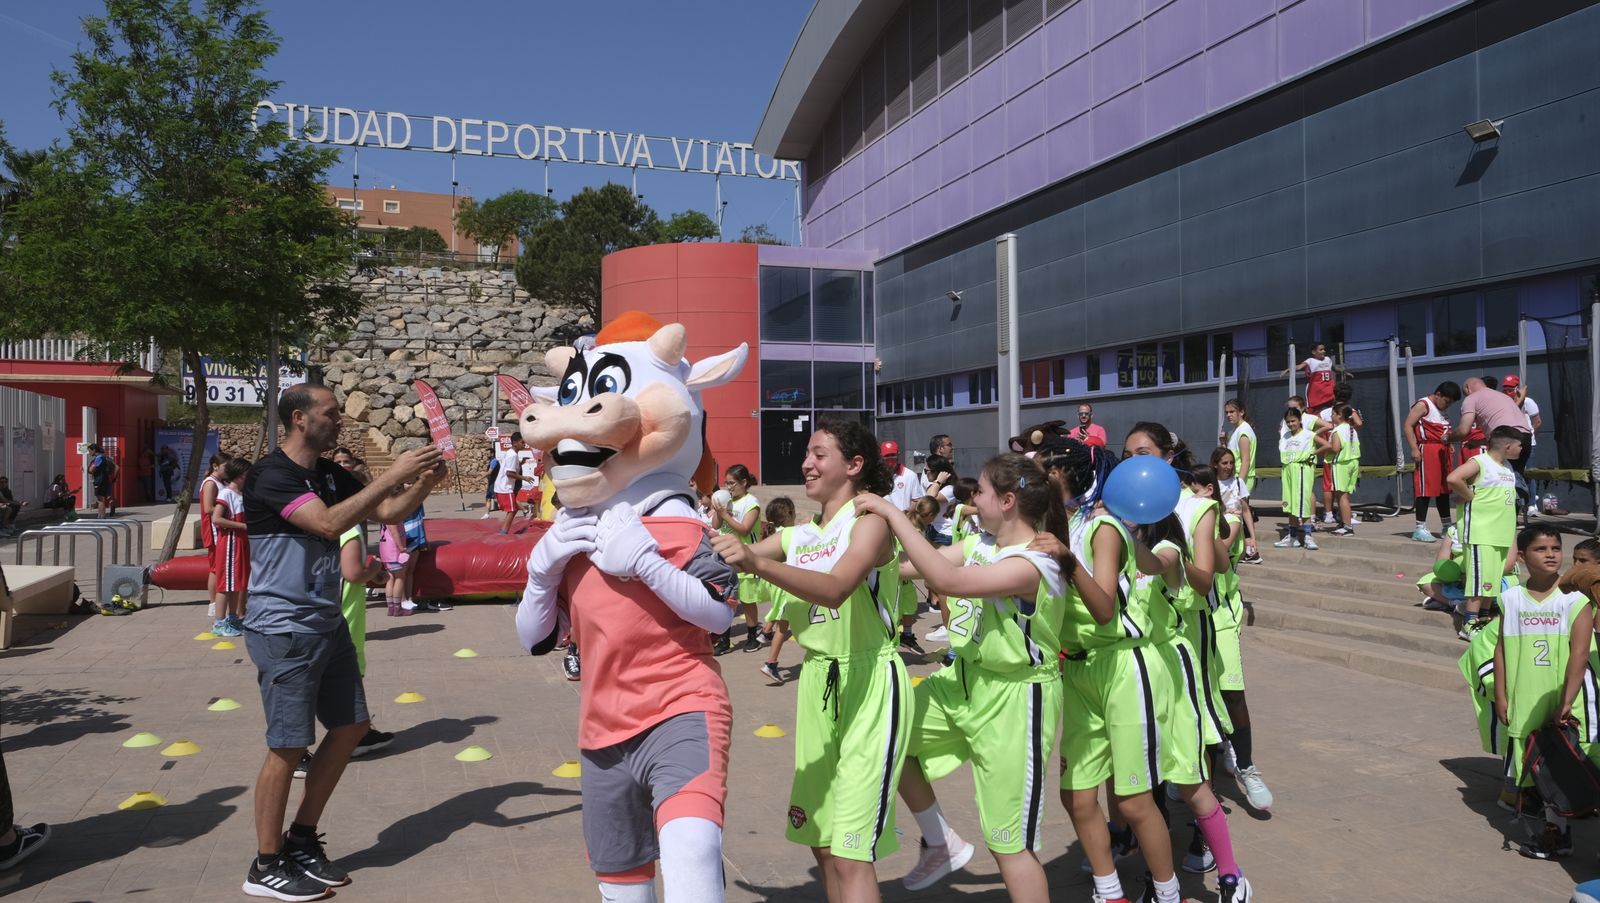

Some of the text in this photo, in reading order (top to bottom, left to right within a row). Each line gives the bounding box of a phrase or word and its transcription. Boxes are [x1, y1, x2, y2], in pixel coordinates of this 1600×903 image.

[251, 100, 412, 149] CIUDAD
[432, 115, 654, 169] DEPORTIVA
[185, 385, 219, 402] 90
[225, 386, 245, 402] 31
[1523, 617, 1559, 626] COVAP
[1533, 640, 1552, 667] 2
[842, 832, 860, 849] 21
[991, 827, 1011, 844] 20
